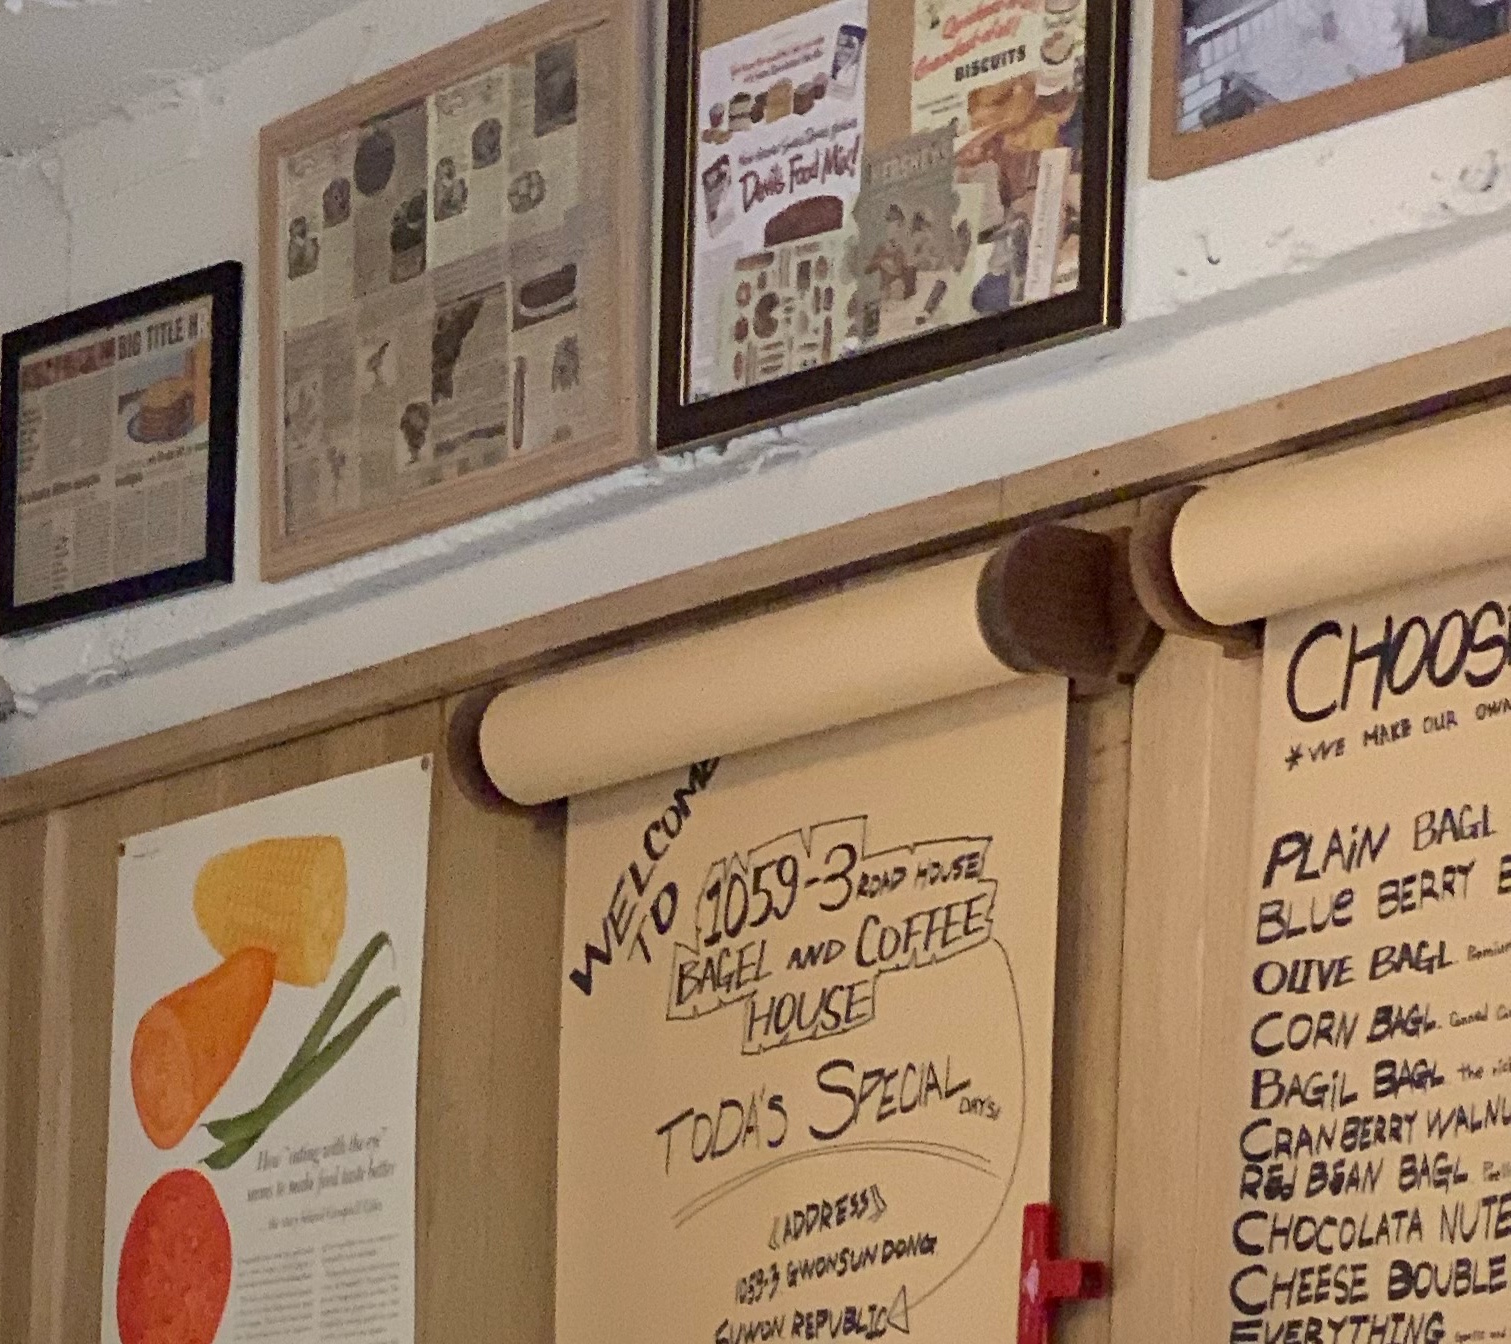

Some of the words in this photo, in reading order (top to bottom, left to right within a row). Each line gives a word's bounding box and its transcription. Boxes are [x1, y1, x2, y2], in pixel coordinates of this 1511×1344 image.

[955, 45, 1026, 81] BISCUITS
[1287, 600, 1511, 723] CHOOS
[1423, 710, 1458, 733] OUR
[1413, 803, 1497, 851] BAGL
[629, 882, 678, 964] TO
[705, 844, 856, 947] 1059-3
[914, 851, 980, 888] HOUSE
[1377, 857, 1476, 919] BERRY
[677, 940, 772, 1006] BAGEL
[787, 940, 845, 969] AND
[856, 894, 986, 968] COFFEE
[1253, 954, 1356, 995] OLIVE
[746, 980, 871, 1041] HOUSE
[1251, 1010, 1358, 1057] CORN
[809, 1056, 971, 1141] SPECIAL
[1229, 1261, 1369, 1316] CHEESE
[792, 1303, 887, 1340] REPUBLIC
